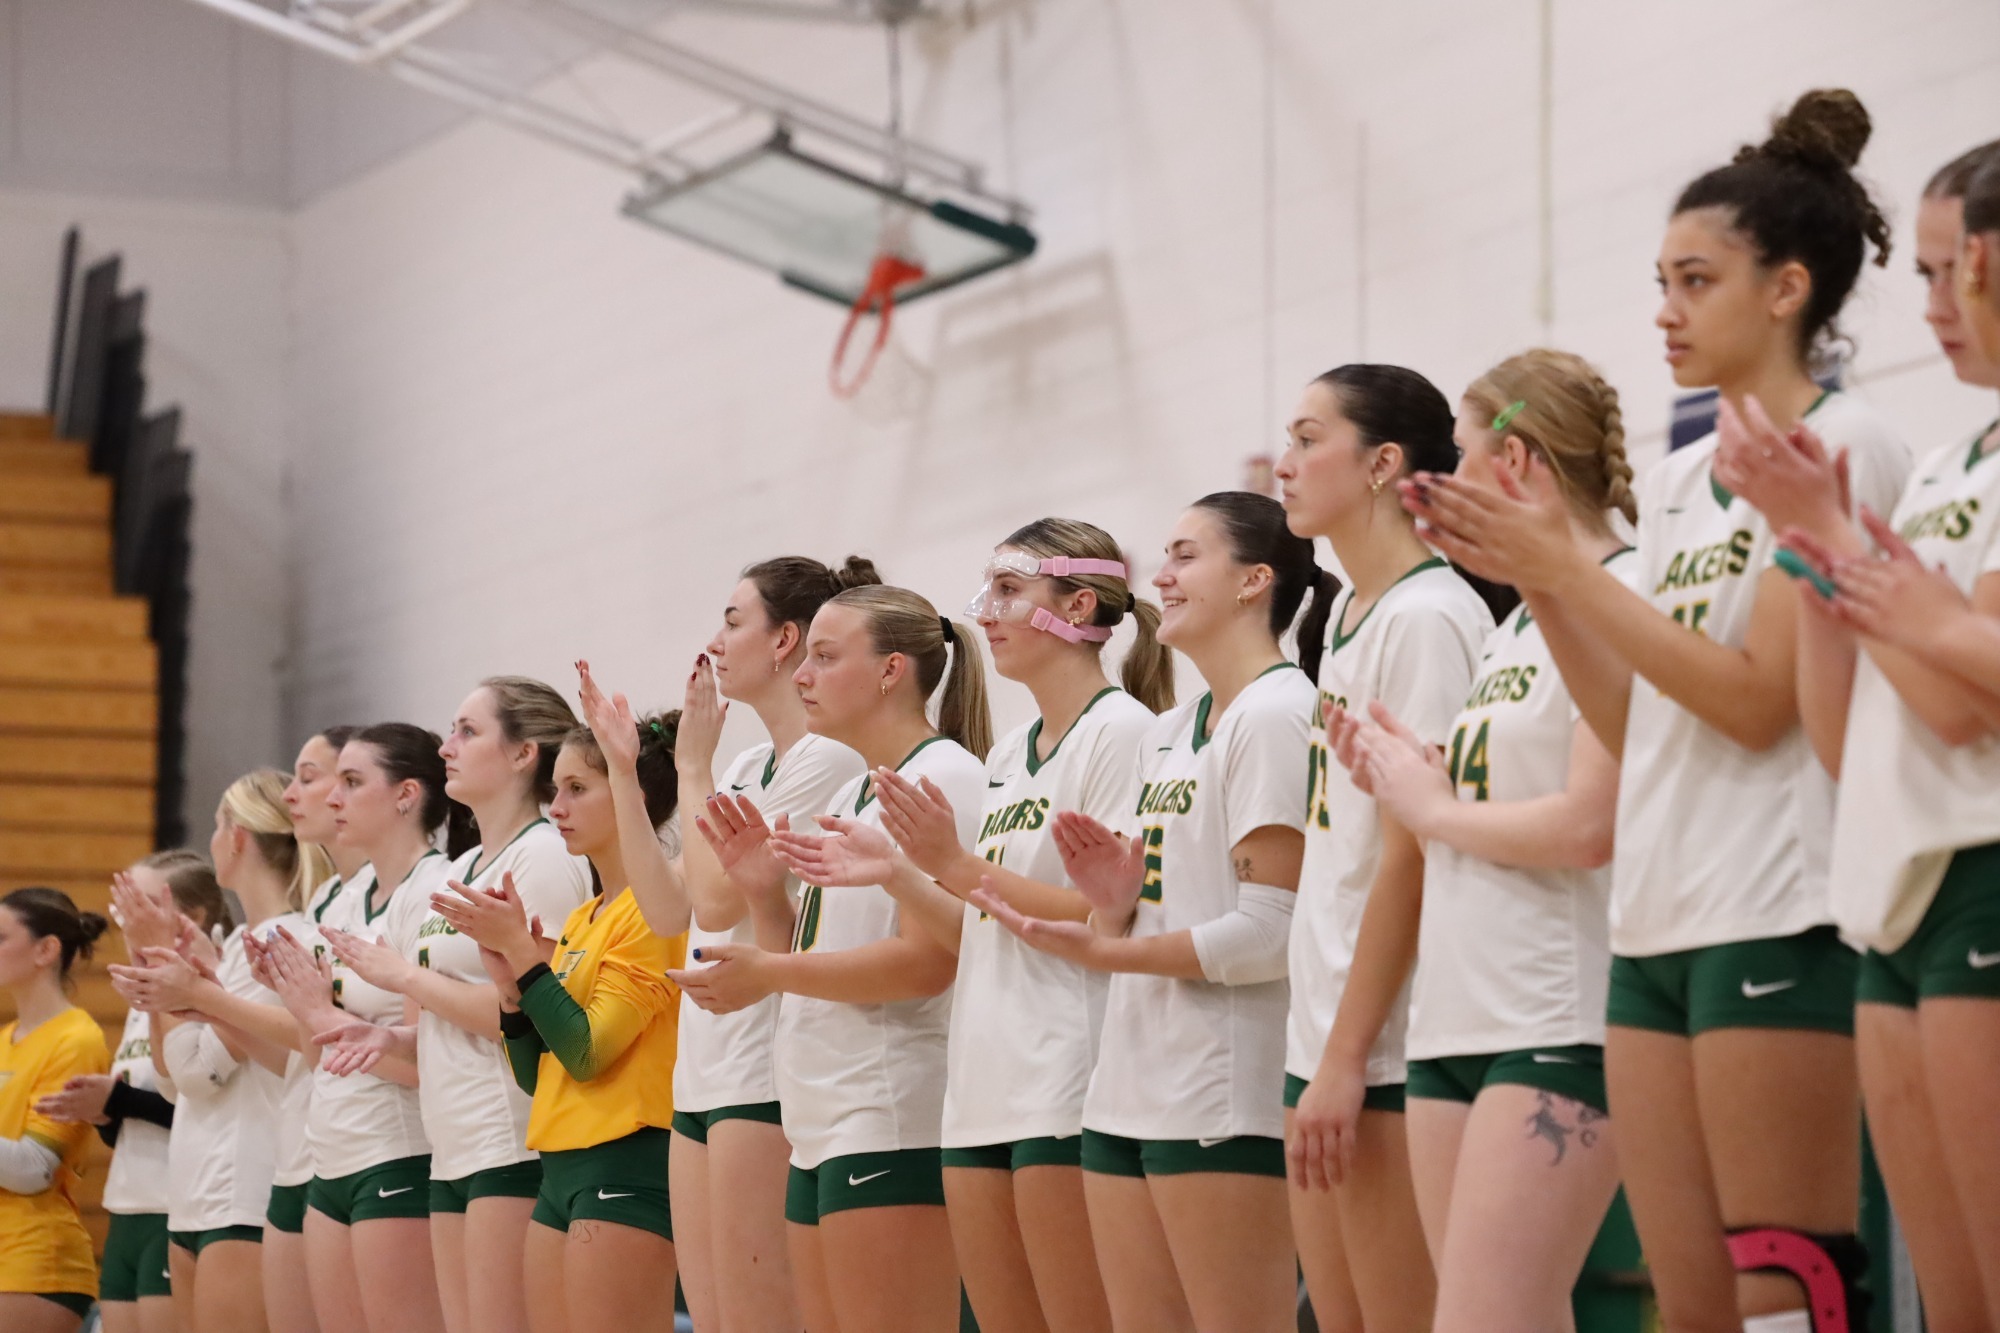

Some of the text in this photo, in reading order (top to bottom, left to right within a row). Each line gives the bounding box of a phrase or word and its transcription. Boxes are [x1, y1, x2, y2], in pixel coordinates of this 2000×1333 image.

[1654, 529, 1753, 596] AKERS
[1464, 665, 1538, 711] AKERS
[1448, 717, 1491, 801] 14
